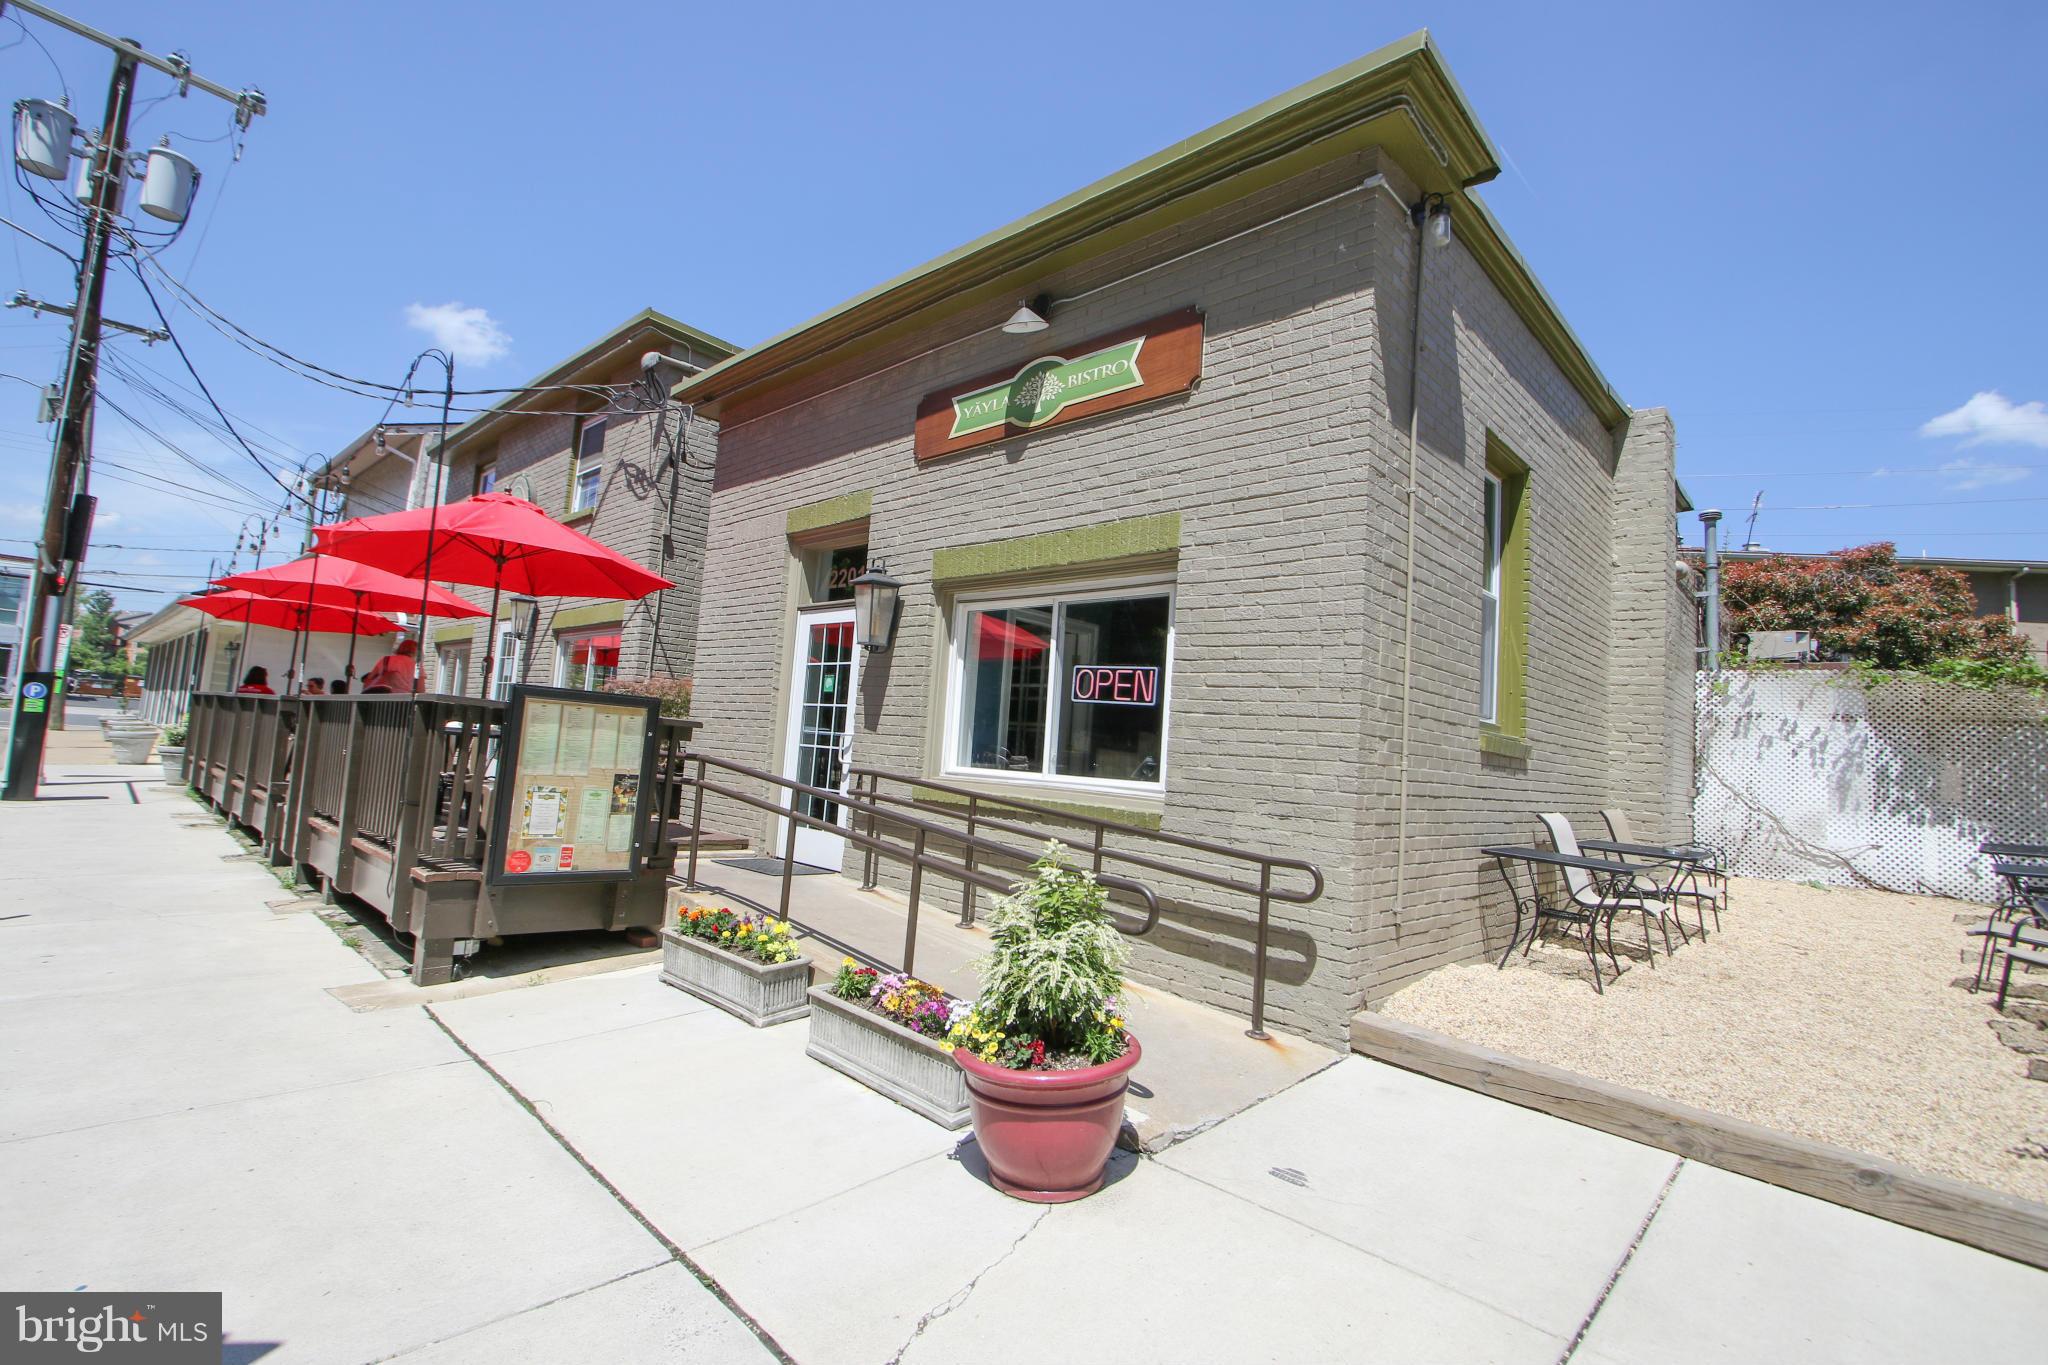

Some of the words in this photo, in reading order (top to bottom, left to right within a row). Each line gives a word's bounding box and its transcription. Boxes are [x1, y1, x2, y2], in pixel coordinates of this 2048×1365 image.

[1067, 359, 1128, 388] BISTRO
[30, 685, 42, 697] P
[1076, 669, 1154, 702] OPEN
